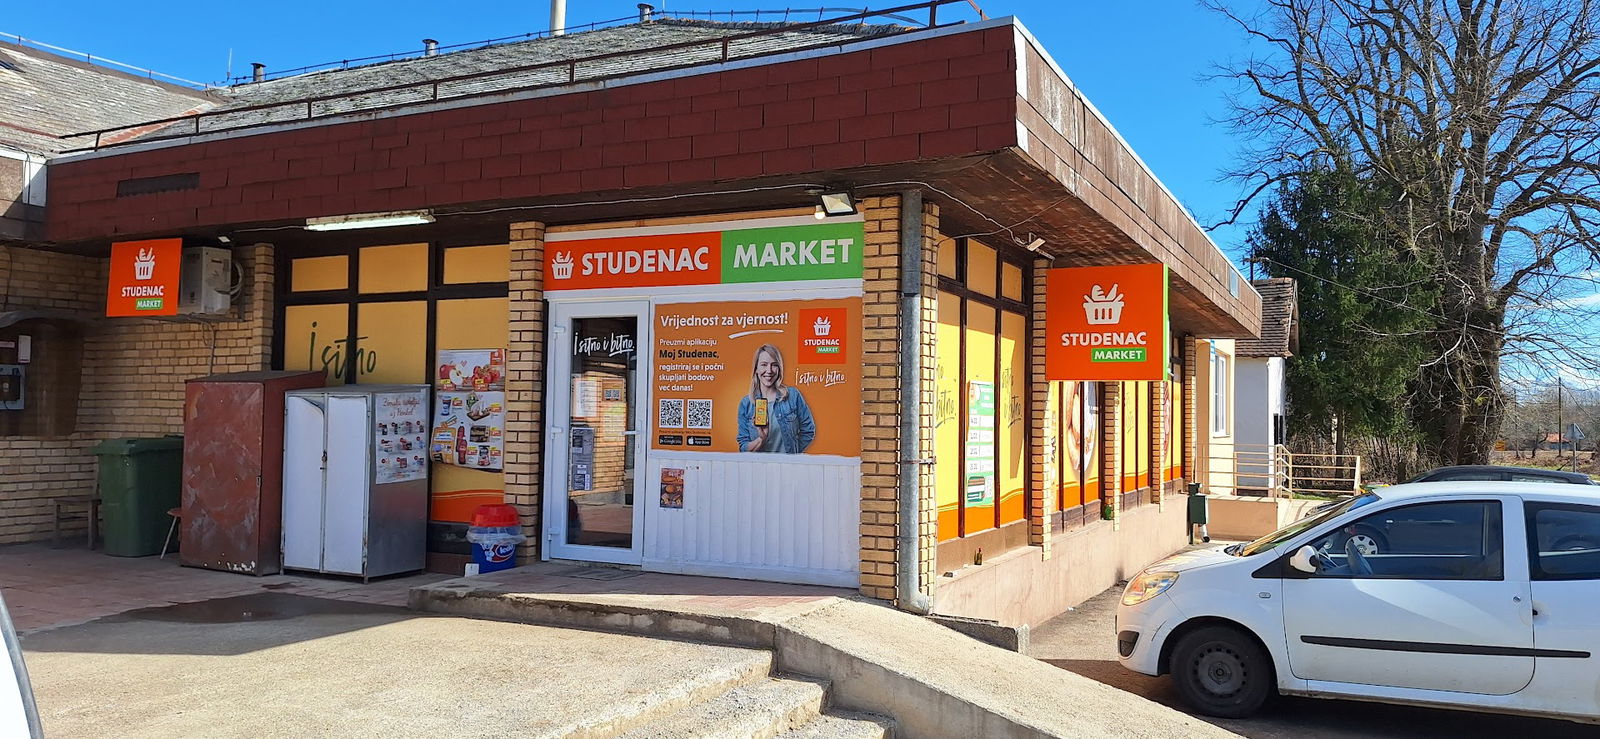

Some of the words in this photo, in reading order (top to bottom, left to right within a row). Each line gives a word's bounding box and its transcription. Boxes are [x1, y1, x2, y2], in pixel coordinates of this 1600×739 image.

[581, 246, 709, 276] STUDENAC
[733, 238, 853, 269] MARKET
[121, 285, 165, 297] STUDENAC
[136, 300, 162, 308] MARKET
[660, 314, 719, 330] Vrijednost
[721, 316, 734, 326] za
[736, 312, 789, 329] vjernost!
[659, 338, 686, 346] Preuzmi
[686, 337, 718, 347] aplikaciju
[1061, 331, 1147, 347] STUDENAC
[578, 337, 601, 357] sitno
[602, 337, 610, 351] i
[659, 349, 676, 360] Moj
[677, 349, 720, 359] Studenac,
[1094, 350, 1143, 360] MARKET
[659, 363, 691, 372] registriraj
[704, 363, 724, 372] počni
[659, 373, 687, 382] skupljati
[799, 372, 818, 387] sitno
